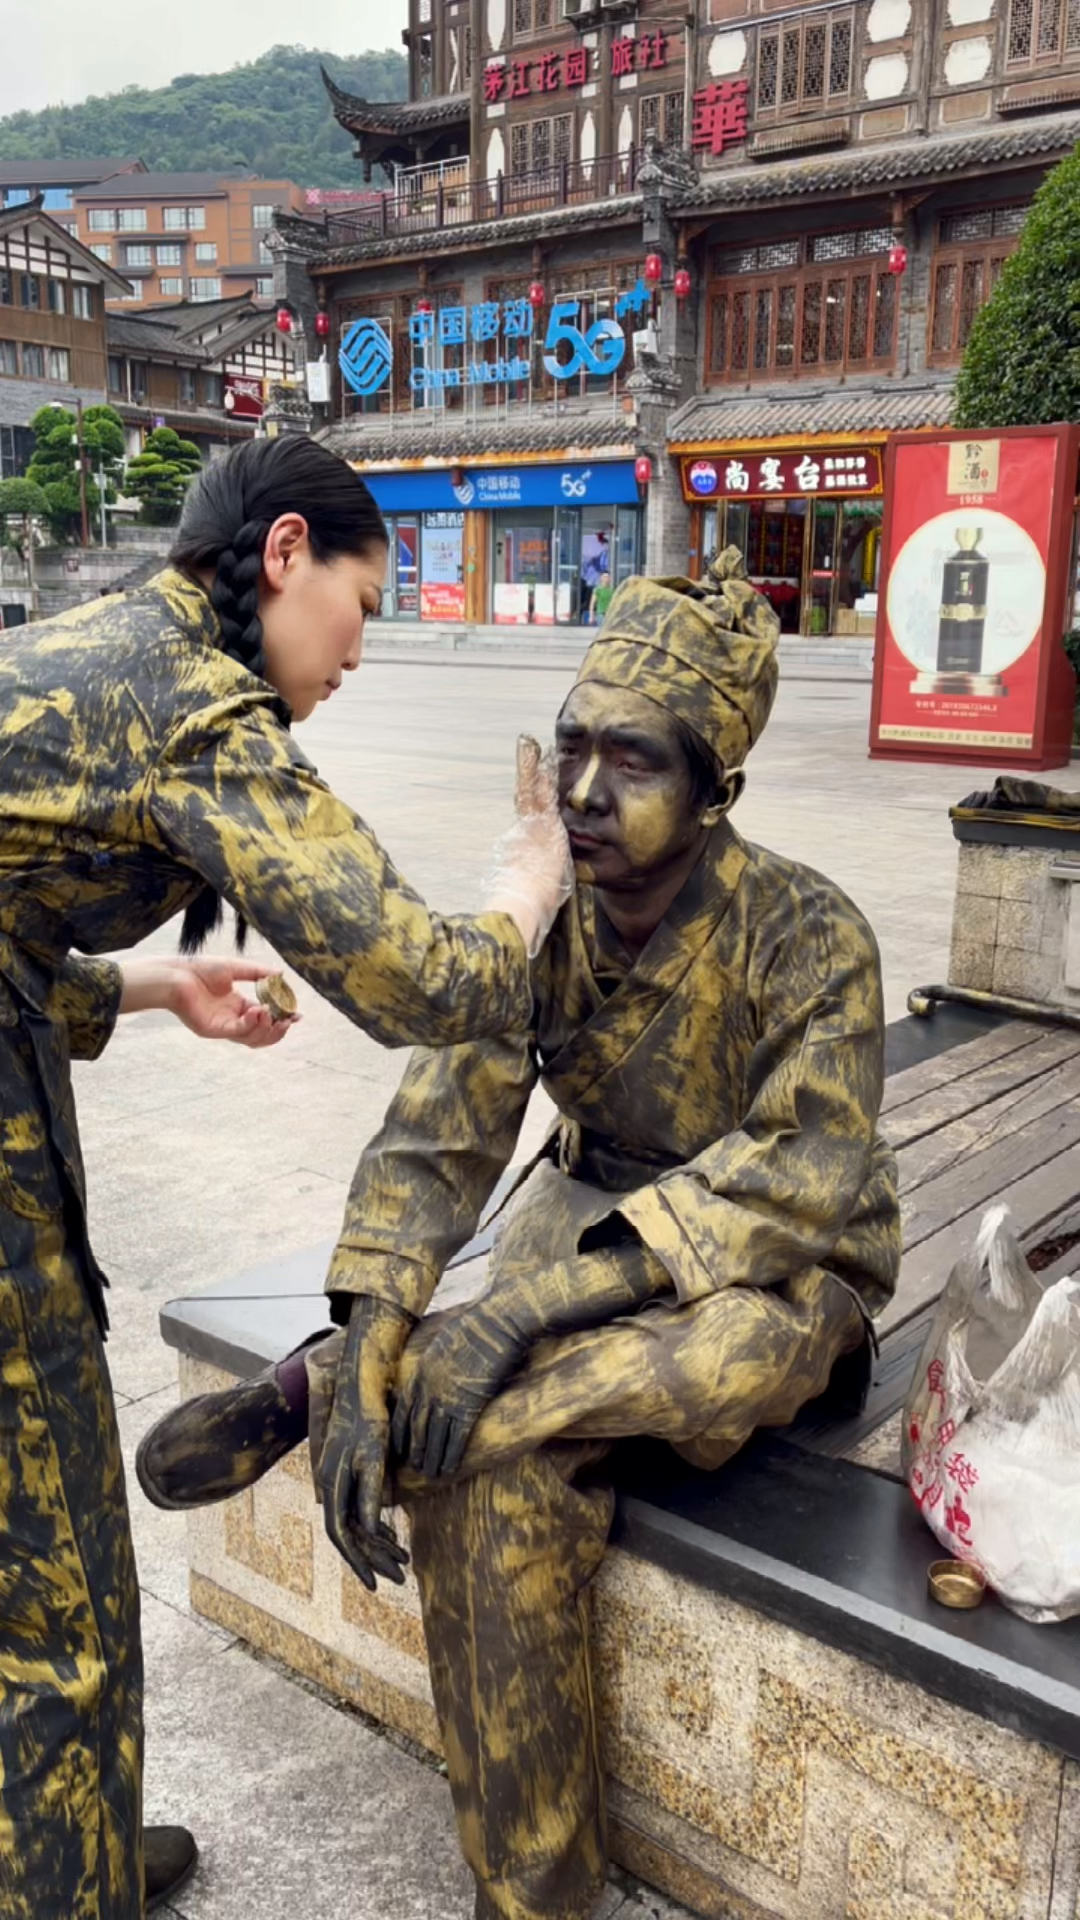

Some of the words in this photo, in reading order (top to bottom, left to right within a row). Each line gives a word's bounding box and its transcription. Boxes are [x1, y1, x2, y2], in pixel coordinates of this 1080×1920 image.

[611, 29, 667, 77] 旅社
[409, 298, 533, 347] 中国移动
[410, 366, 460, 390] China
[469, 357, 531, 384] Mobile
[477, 475, 521, 490] 中国移动
[725, 455, 820, 492] 尚宴台
